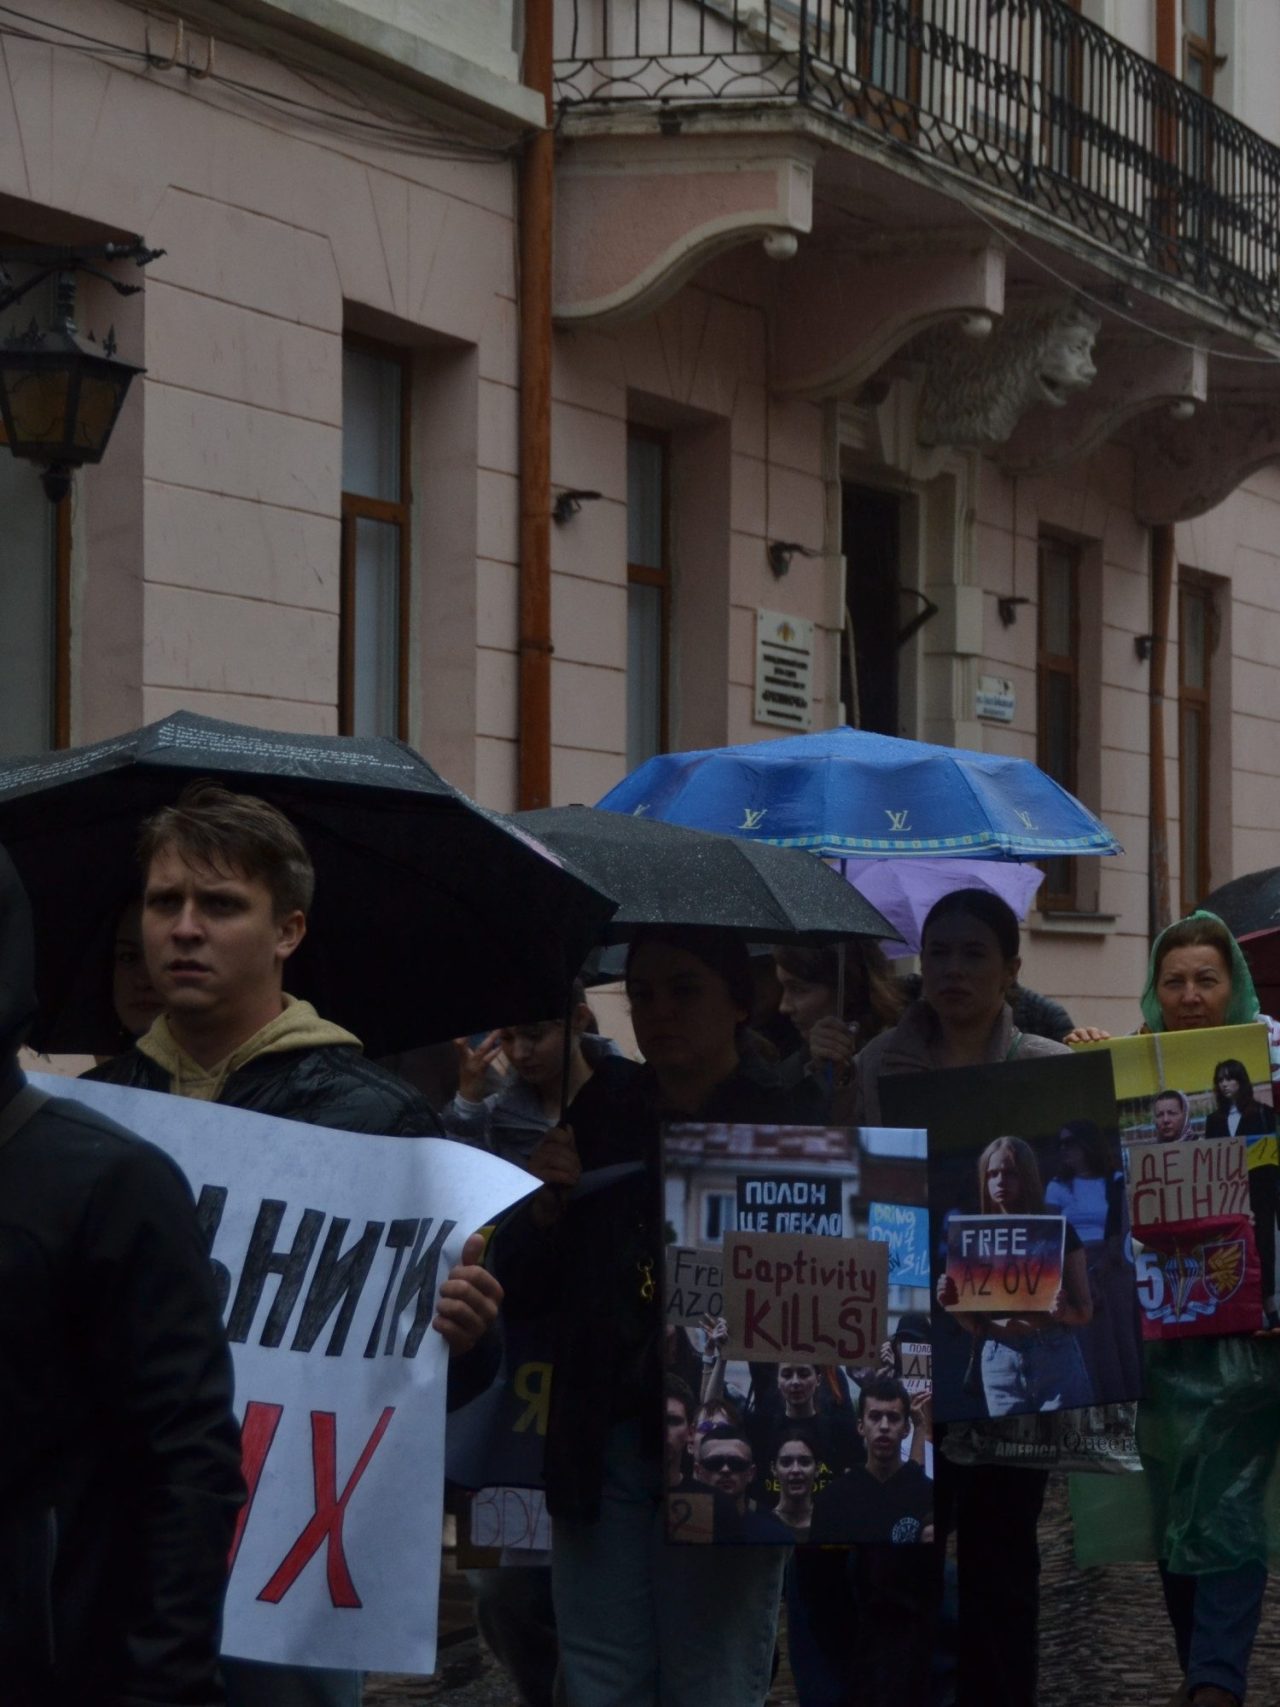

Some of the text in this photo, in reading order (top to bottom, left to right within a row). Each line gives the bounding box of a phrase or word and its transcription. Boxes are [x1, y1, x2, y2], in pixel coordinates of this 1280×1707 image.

[1136, 1150, 1184, 1191] ДЕ
[745, 1180, 827, 1206] ПОЛОН
[776, 1211, 842, 1237] ПЕКЛО
[961, 1227, 1028, 1257] FREE
[732, 1244, 877, 1304] Captivity
[743, 1288, 878, 1360] KILLS!
